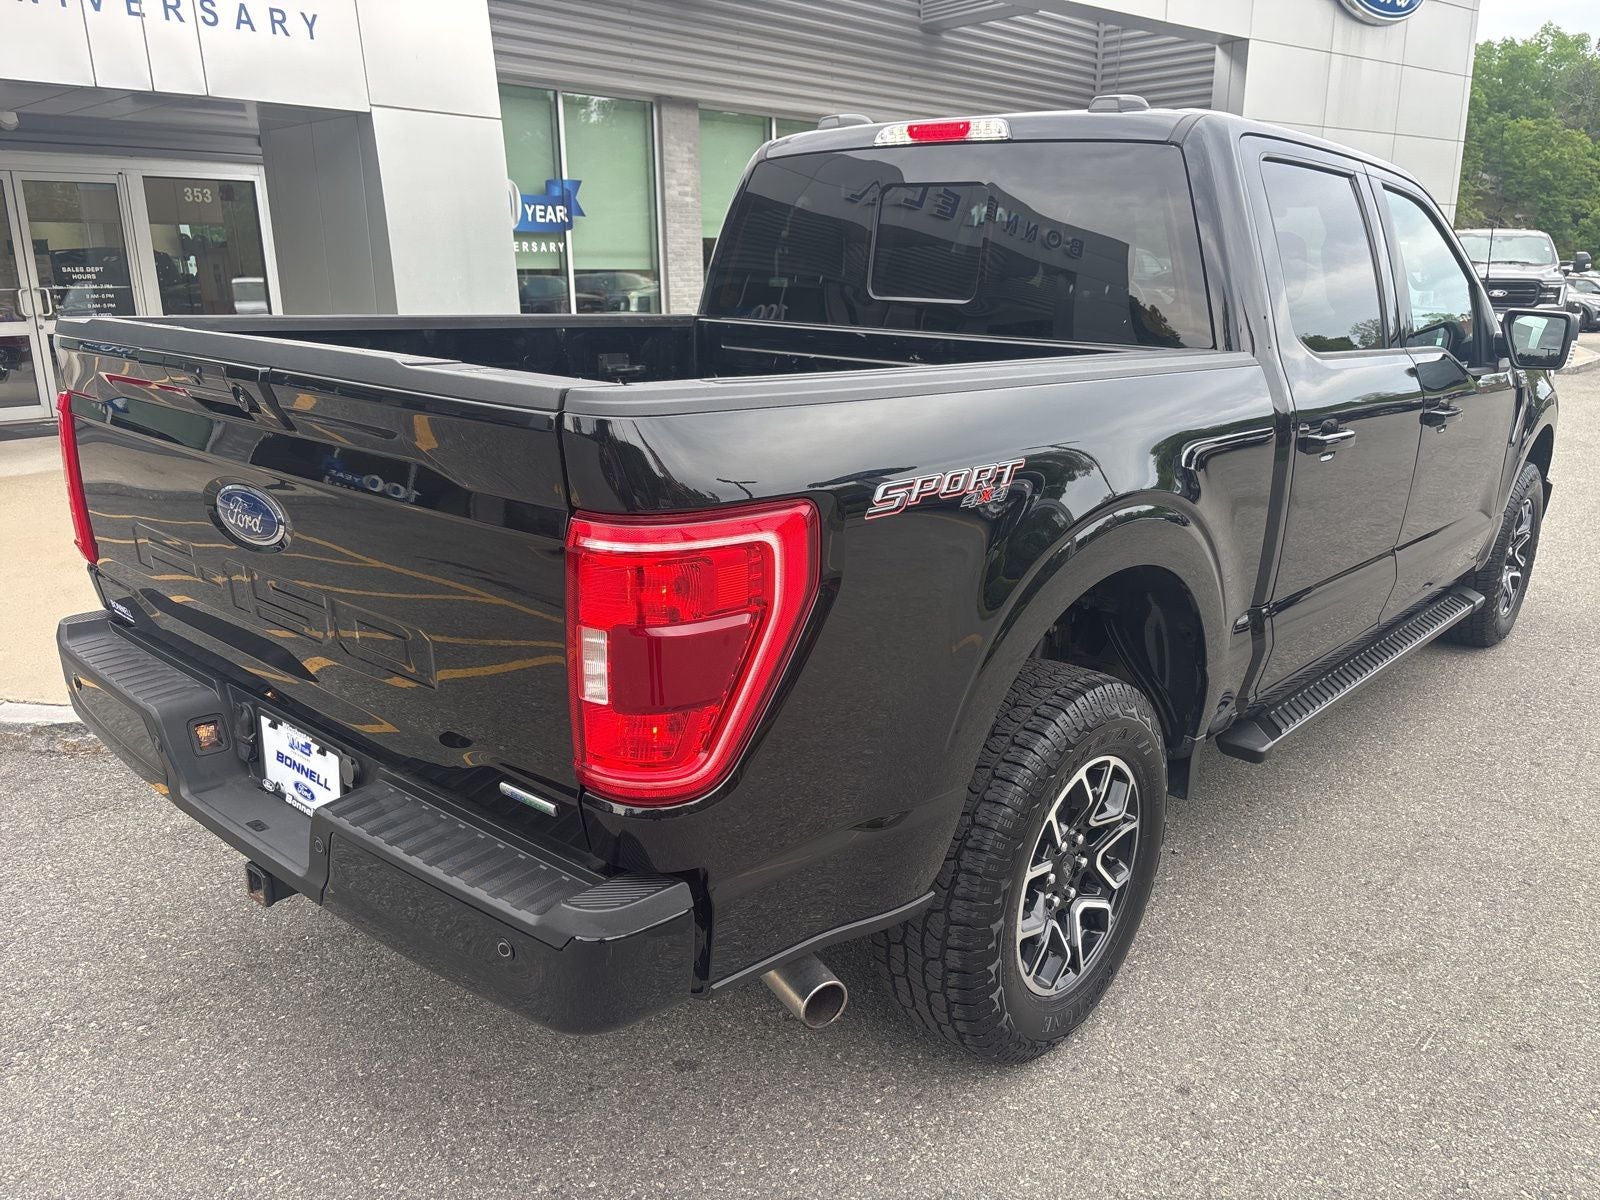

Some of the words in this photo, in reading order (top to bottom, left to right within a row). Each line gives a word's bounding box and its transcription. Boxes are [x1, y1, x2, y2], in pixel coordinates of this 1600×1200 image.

[17, 0, 318, 40] ERSARY
[183, 187, 212, 203] 353
[524, 203, 569, 223] YEAR
[513, 241, 565, 253] ERSARY
[865, 458, 1026, 520] SPORT
[226, 495, 266, 534] Ford
[276, 750, 331, 791] BONNELL
